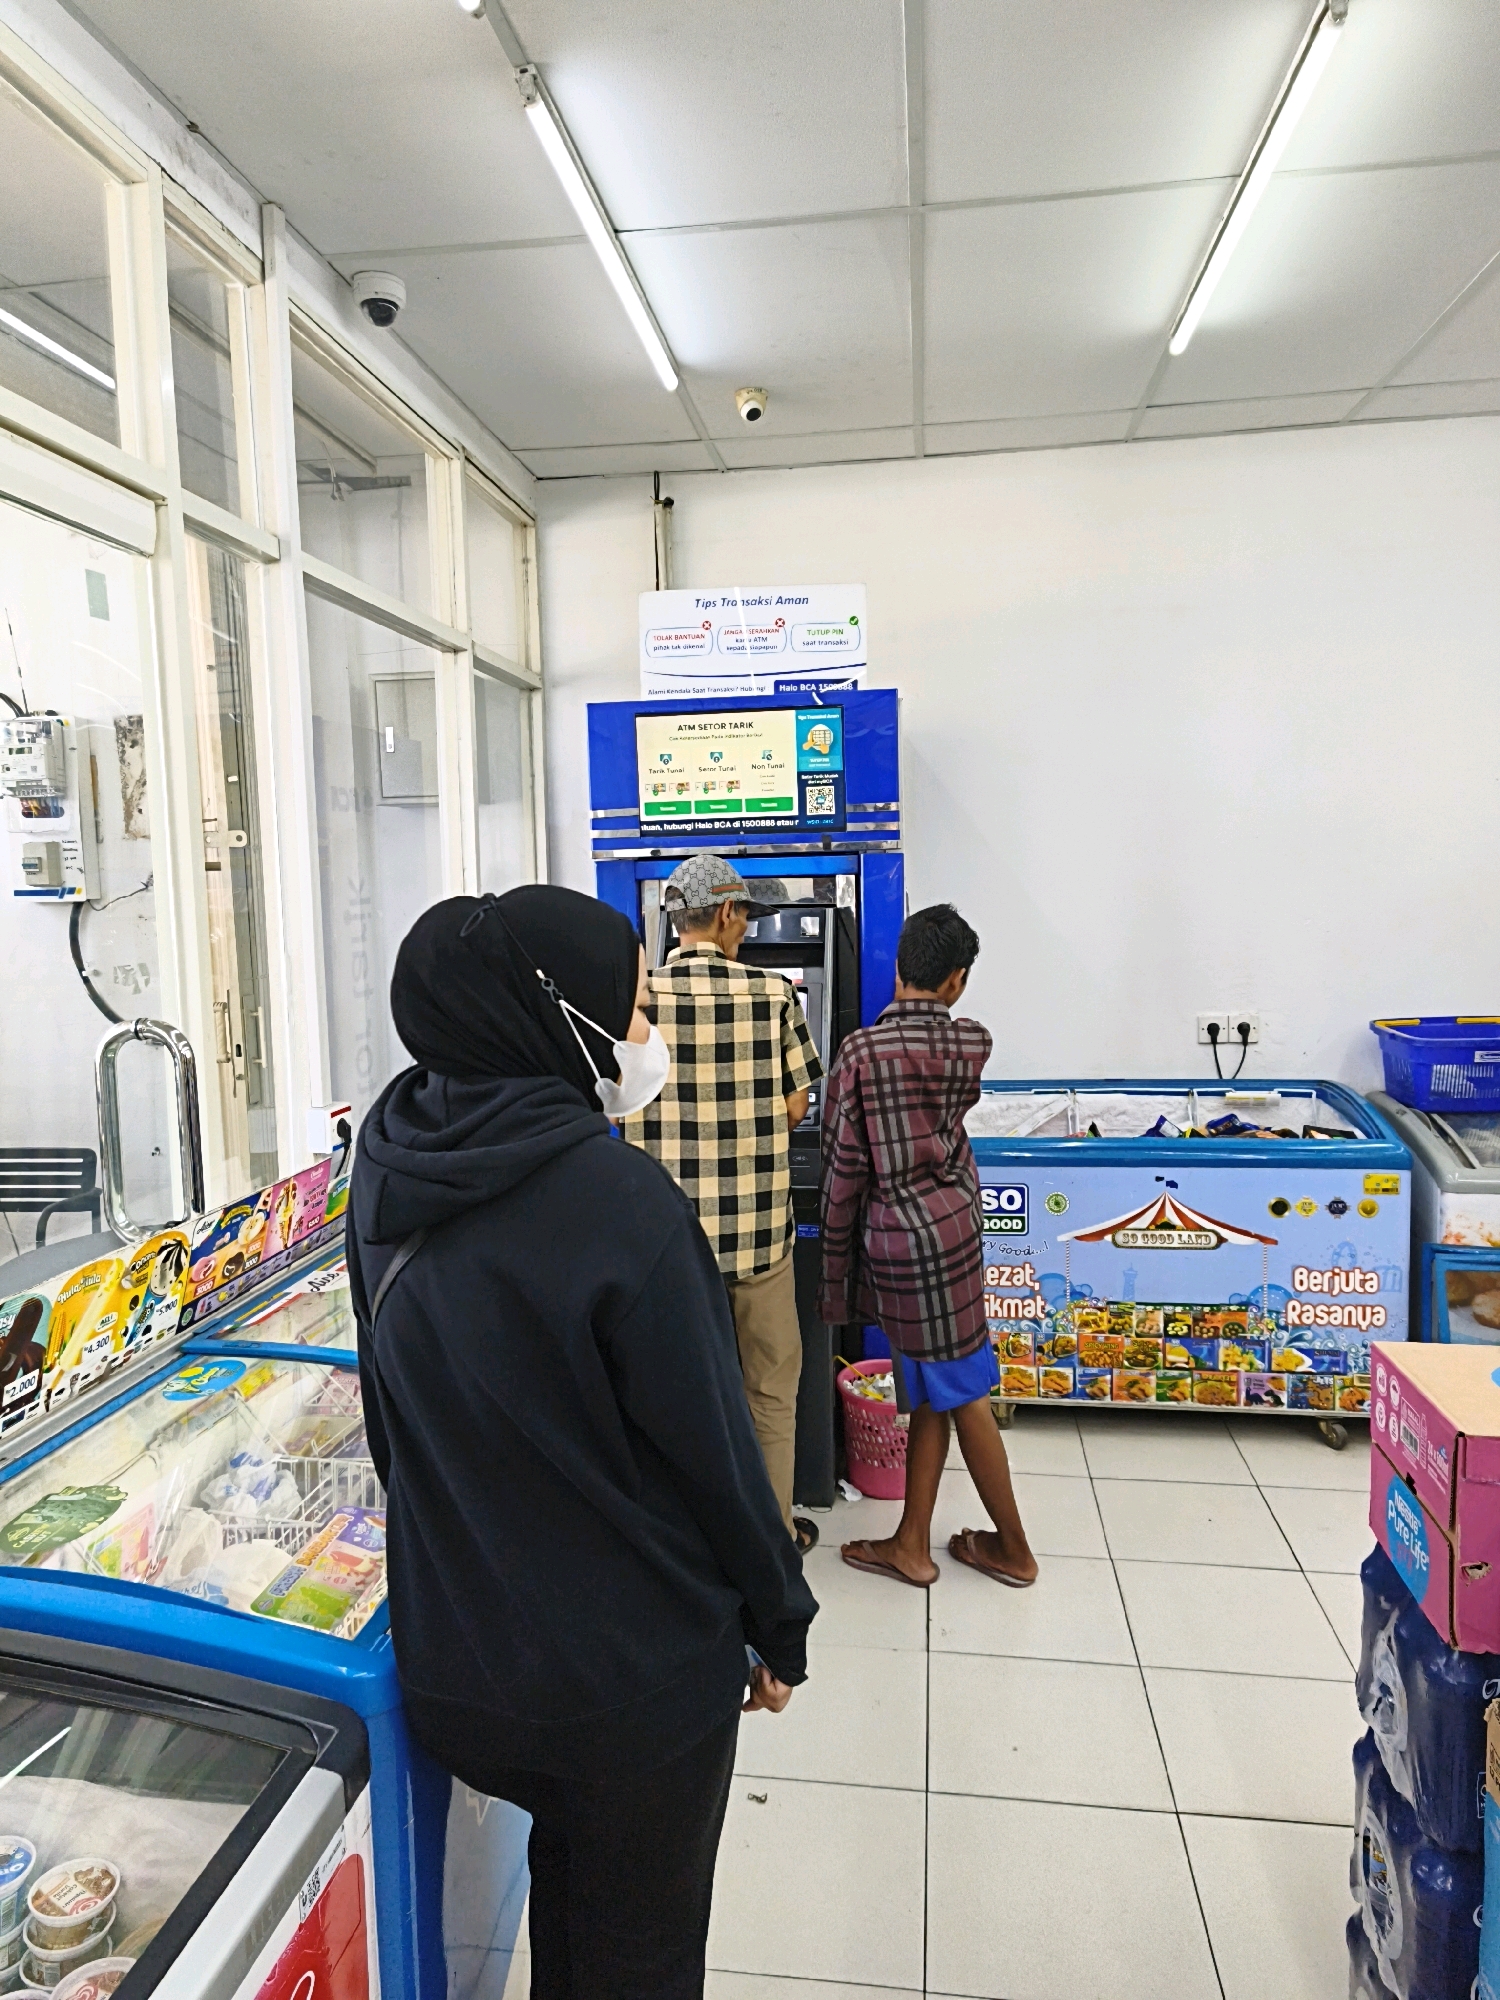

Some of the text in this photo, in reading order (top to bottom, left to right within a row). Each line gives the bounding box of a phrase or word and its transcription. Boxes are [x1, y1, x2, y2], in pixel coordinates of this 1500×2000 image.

[694, 595, 809, 610] Tips Transaksi Aman
[653, 644, 670, 652] pihak
[779, 684, 798, 692] Halo
[800, 683, 817, 691] BCA
[698, 723, 727, 731] SETOR
[728, 721, 754, 729] TARIK
[664, 823, 694, 831] hubungi
[714, 821, 731, 829] BCA
[742, 819, 775, 827] 1500888
[980, 1188, 1023, 1211] SO
[983, 1218, 1023, 1230] GOOD
[1122, 1233, 1212, 1245] SO GOOD LAND
[308, 1272, 340, 1292] Aice
[984, 1263, 1040, 1291] ezat,
[1293, 1267, 1379, 1296] Berjuta
[984, 1294, 1046, 1318] ikmat
[1286, 1299, 1386, 1331] Rasanya
[87, 1335, 110, 1354] 4.300
[10, 1375, 36, 1397] 2.000
[1388, 1499, 1428, 1572] Pure Life
